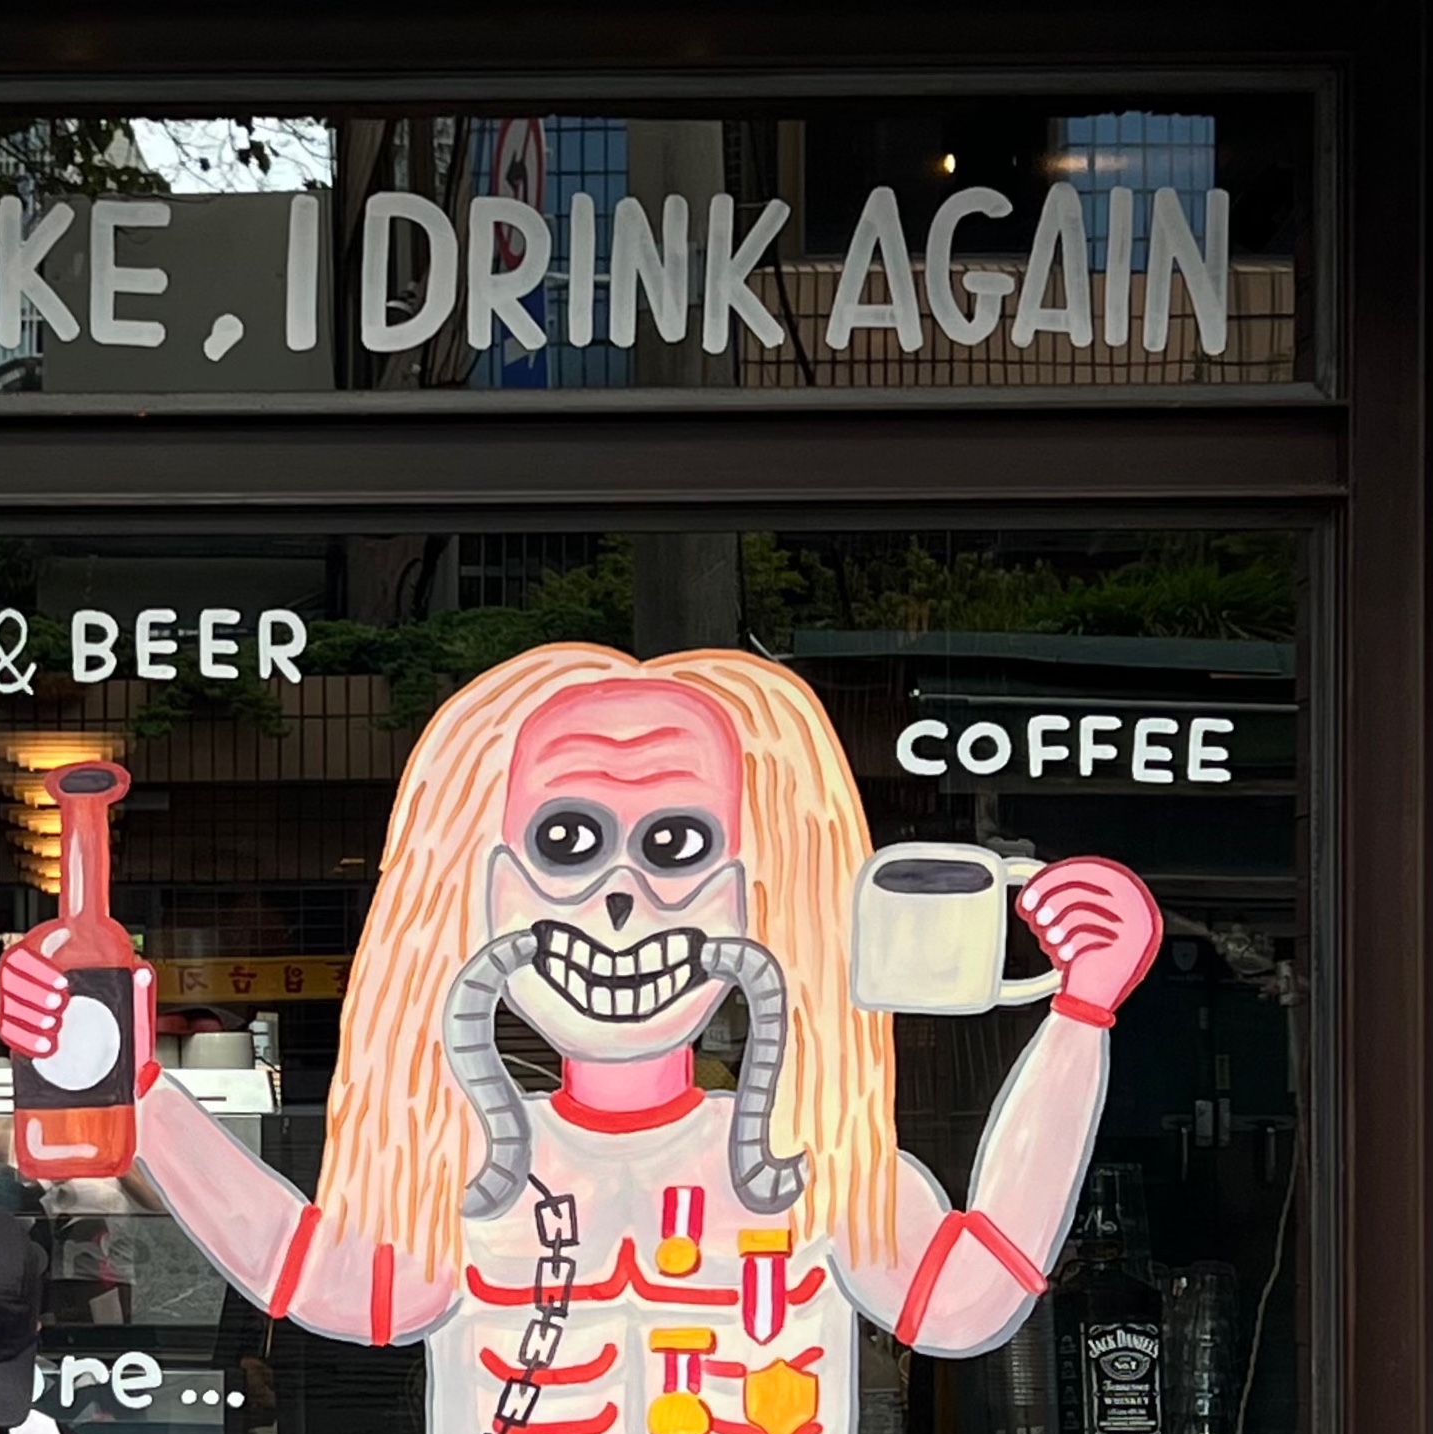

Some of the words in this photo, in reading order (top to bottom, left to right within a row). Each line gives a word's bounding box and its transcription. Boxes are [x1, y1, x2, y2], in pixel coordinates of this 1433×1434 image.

[285, 194, 319, 351] I
[361, 191, 791, 354] DRINK
[825, 181, 1230, 355] AGAIN
[71, 608, 308, 684] BEER
[896, 714, 1235, 784] COFFEE
[1087, 1334, 1117, 1358] JACK
